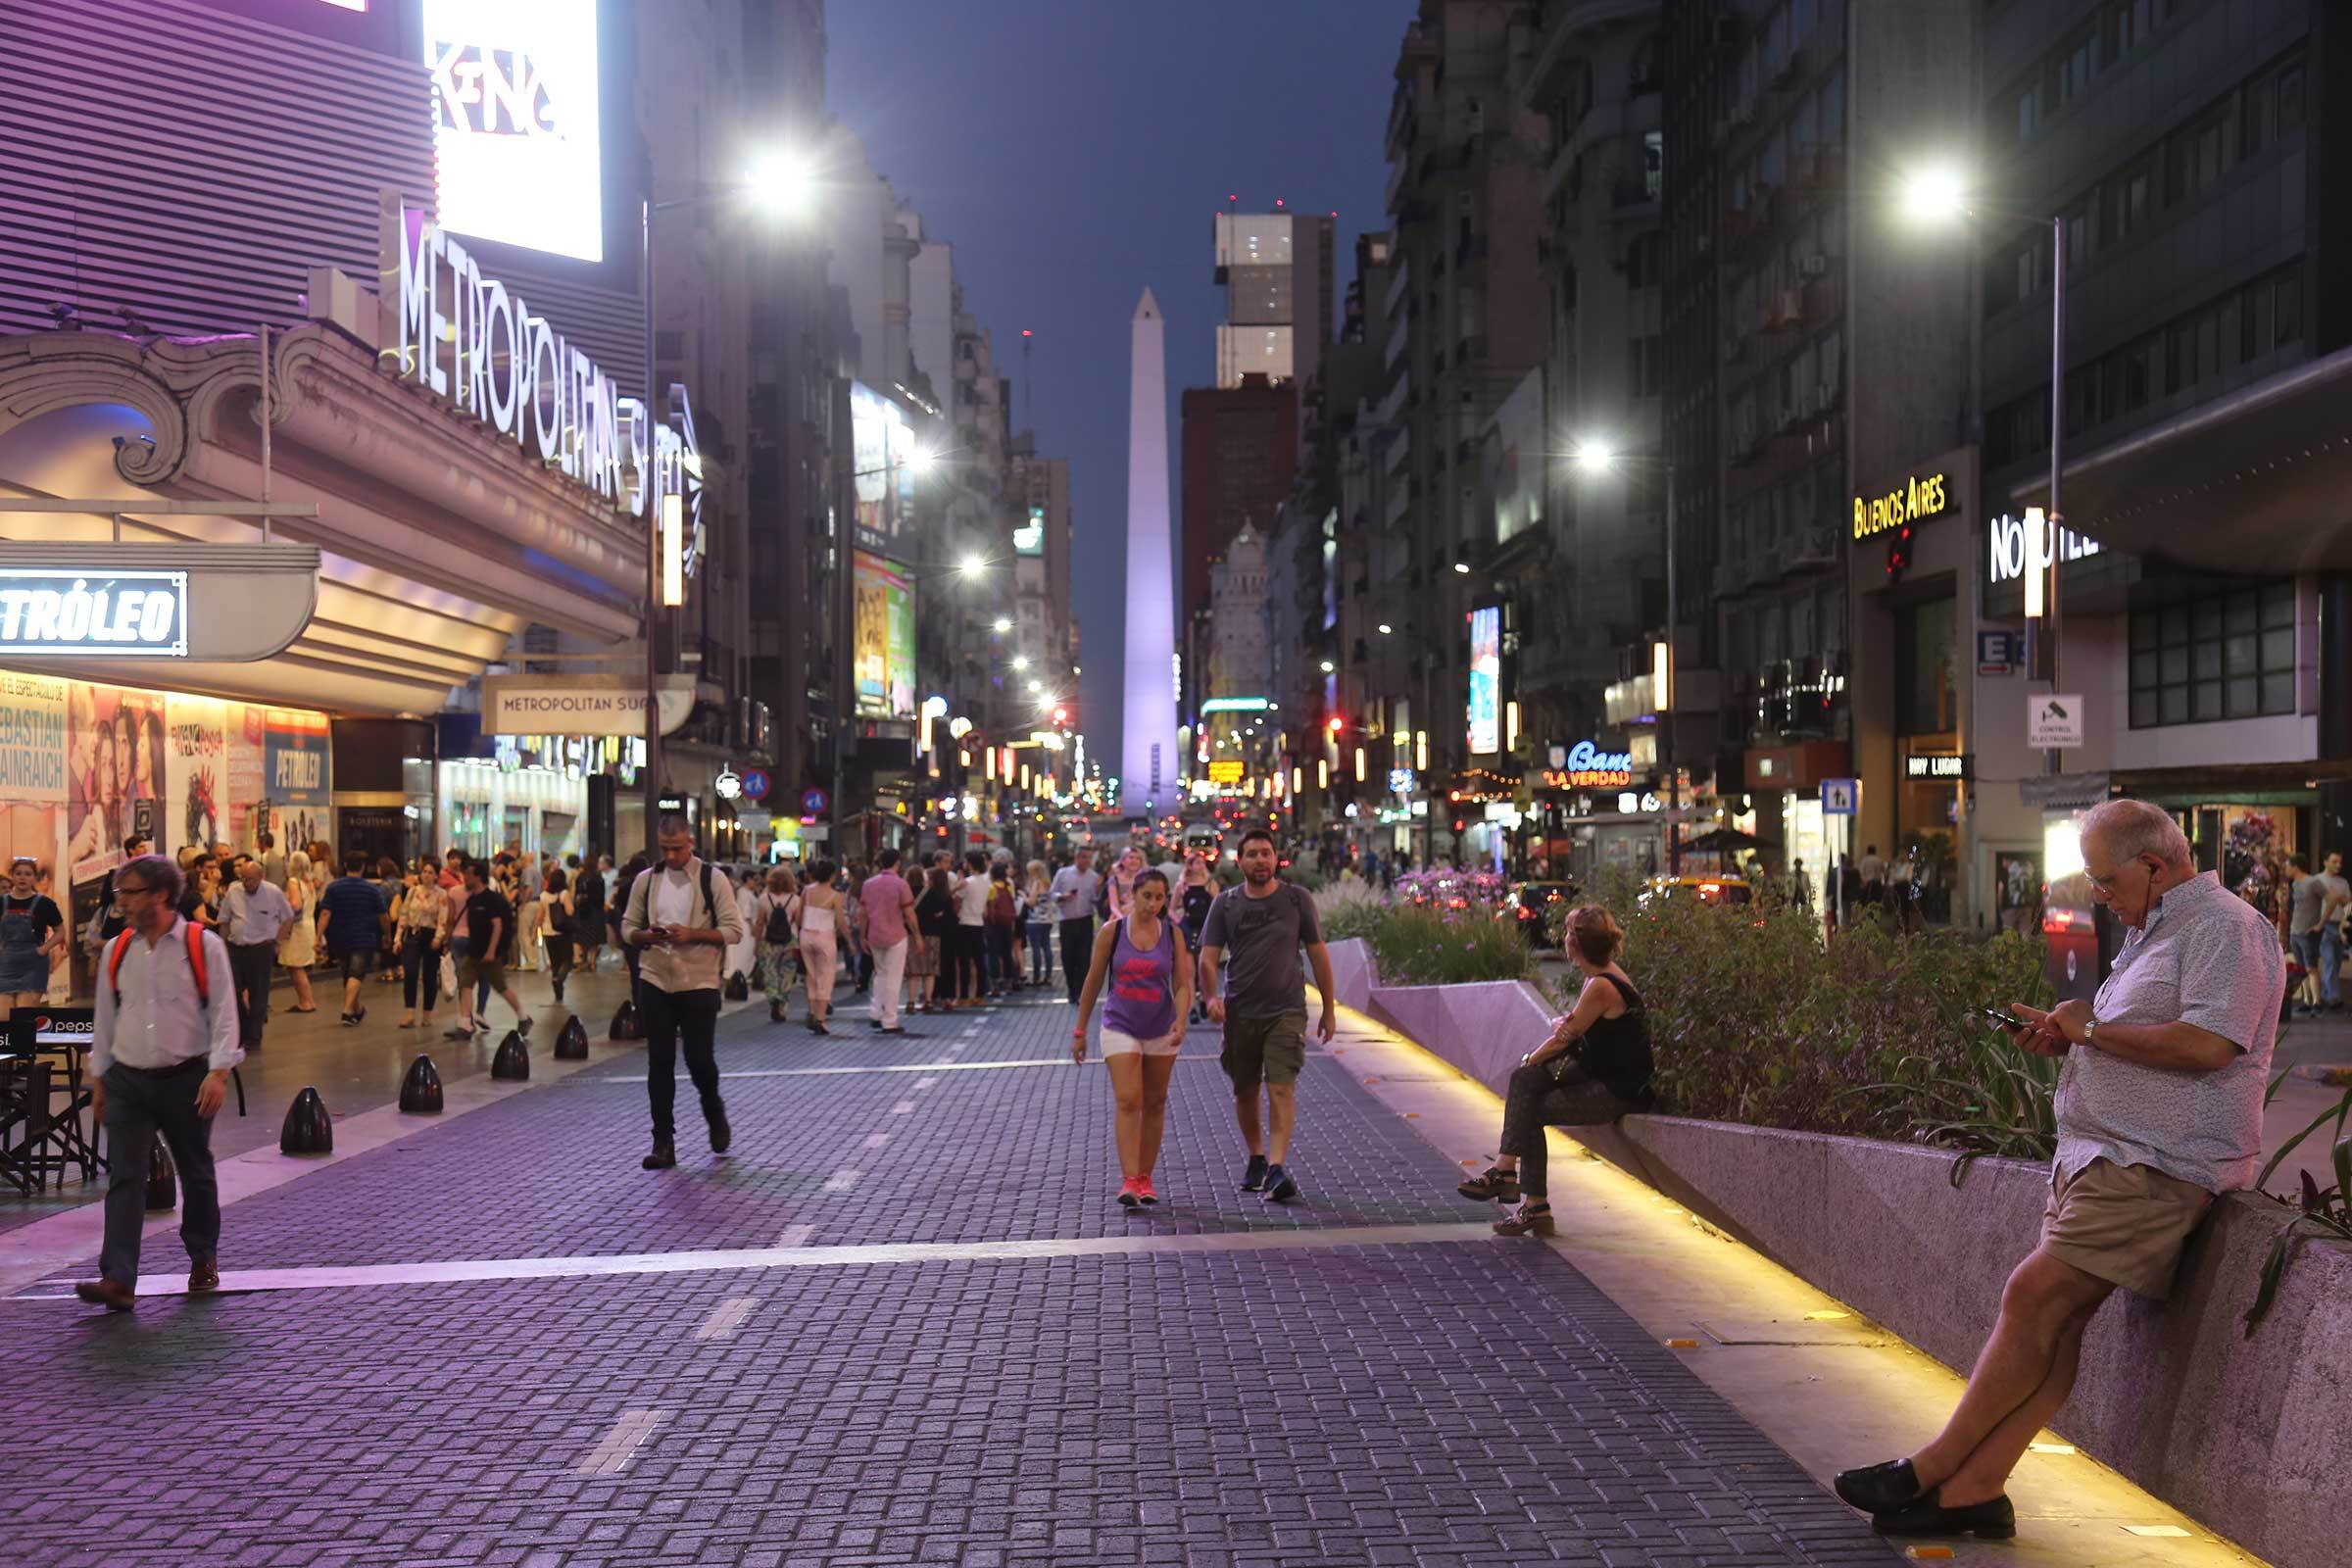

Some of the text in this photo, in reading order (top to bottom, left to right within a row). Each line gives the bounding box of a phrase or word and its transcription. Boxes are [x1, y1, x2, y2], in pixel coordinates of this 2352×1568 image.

[400, 195, 620, 499] METROPOLITAN
[1854, 473, 1945, 539] BUENOS AIRES
[504, 697, 612, 711] METROPOLITAN
[1570, 771, 1630, 786] VERDAD
